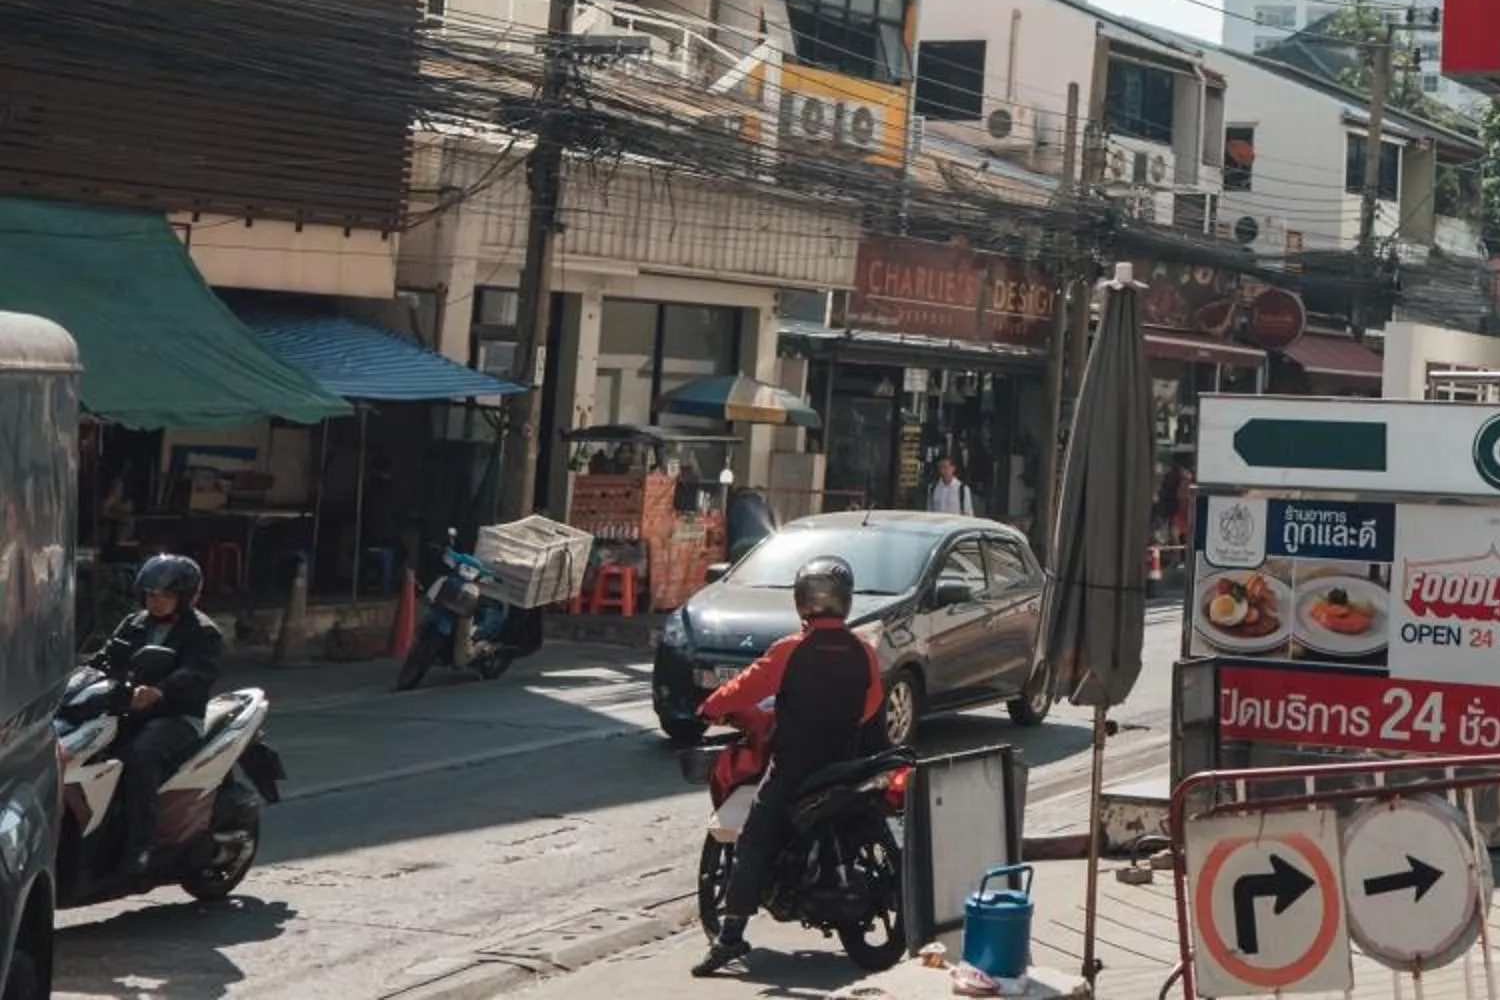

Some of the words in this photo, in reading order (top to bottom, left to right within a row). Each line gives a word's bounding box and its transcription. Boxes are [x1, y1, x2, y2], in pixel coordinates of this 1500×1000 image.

[868, 260, 974, 305] CHARLIE'S
[1283, 519, 1377, 553] ถูกและดี
[1401, 623, 1462, 647] OPEN
[1469, 628, 1493, 648] 24
[1380, 687, 1446, 743] 24
